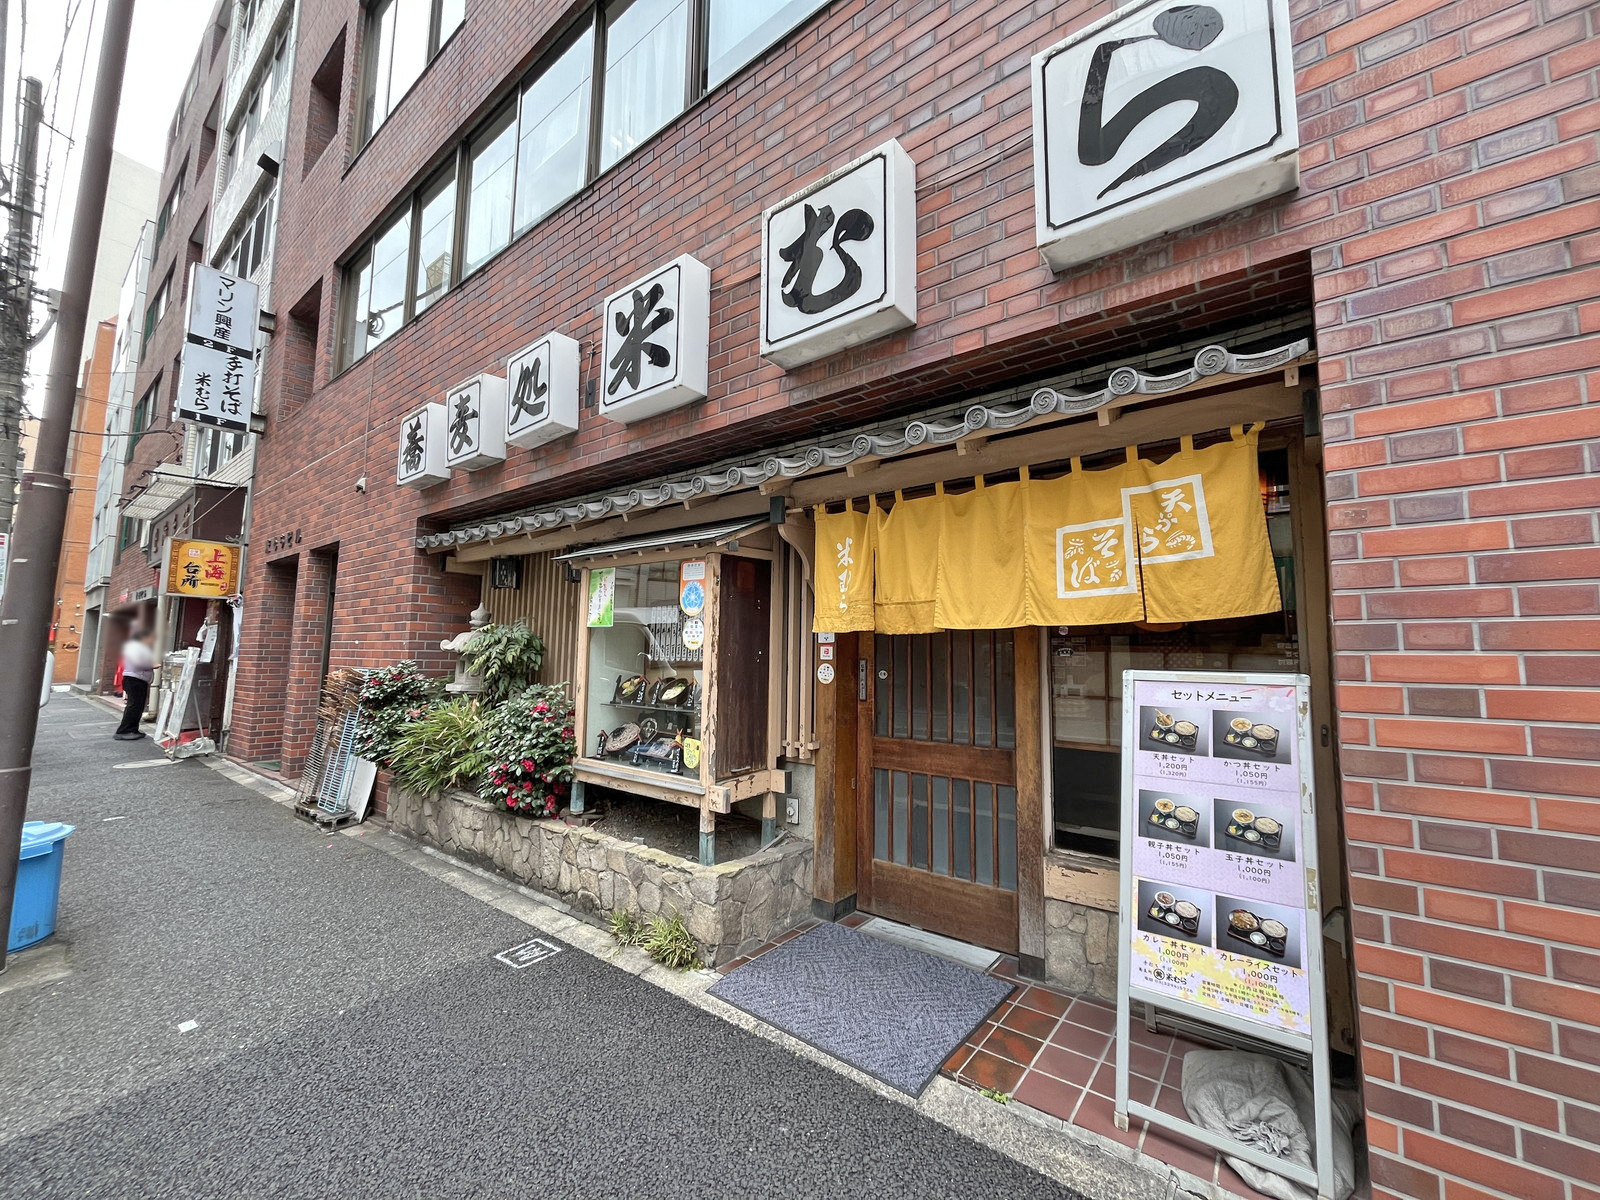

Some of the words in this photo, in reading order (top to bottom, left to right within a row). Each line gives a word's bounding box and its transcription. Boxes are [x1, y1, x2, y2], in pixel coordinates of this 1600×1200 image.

[213, 275, 236, 342] マリン興産
[194, 372, 212, 411] 米むら
[220, 355, 243, 416] 手打そば
[205, 548, 227, 580] 上海
[1069, 527, 1118, 588] そば
[181, 561, 202, 588] 台所
[1171, 690, 1253, 703] セットメニュー
[1153, 753, 1195, 764] 天丼セット
[1158, 762, 1188, 771] 1,200円
[1223, 760, 1281, 772] かつ丼セット
[1235, 770, 1268, 780] 1,050円
[1148, 841, 1200, 856] 親子丼セット
[1158, 851, 1188, 862] 1,050円
[1225, 853, 1284, 870] 玉子丼セット
[1237, 865, 1271, 877] 1,000円
[1143, 934, 1206, 955] カレー丼セット
[1158, 946, 1189, 961] 1,000円
[1220, 953, 1298, 978] カレーライスセット
[1242, 968, 1278, 984] 1,000円
